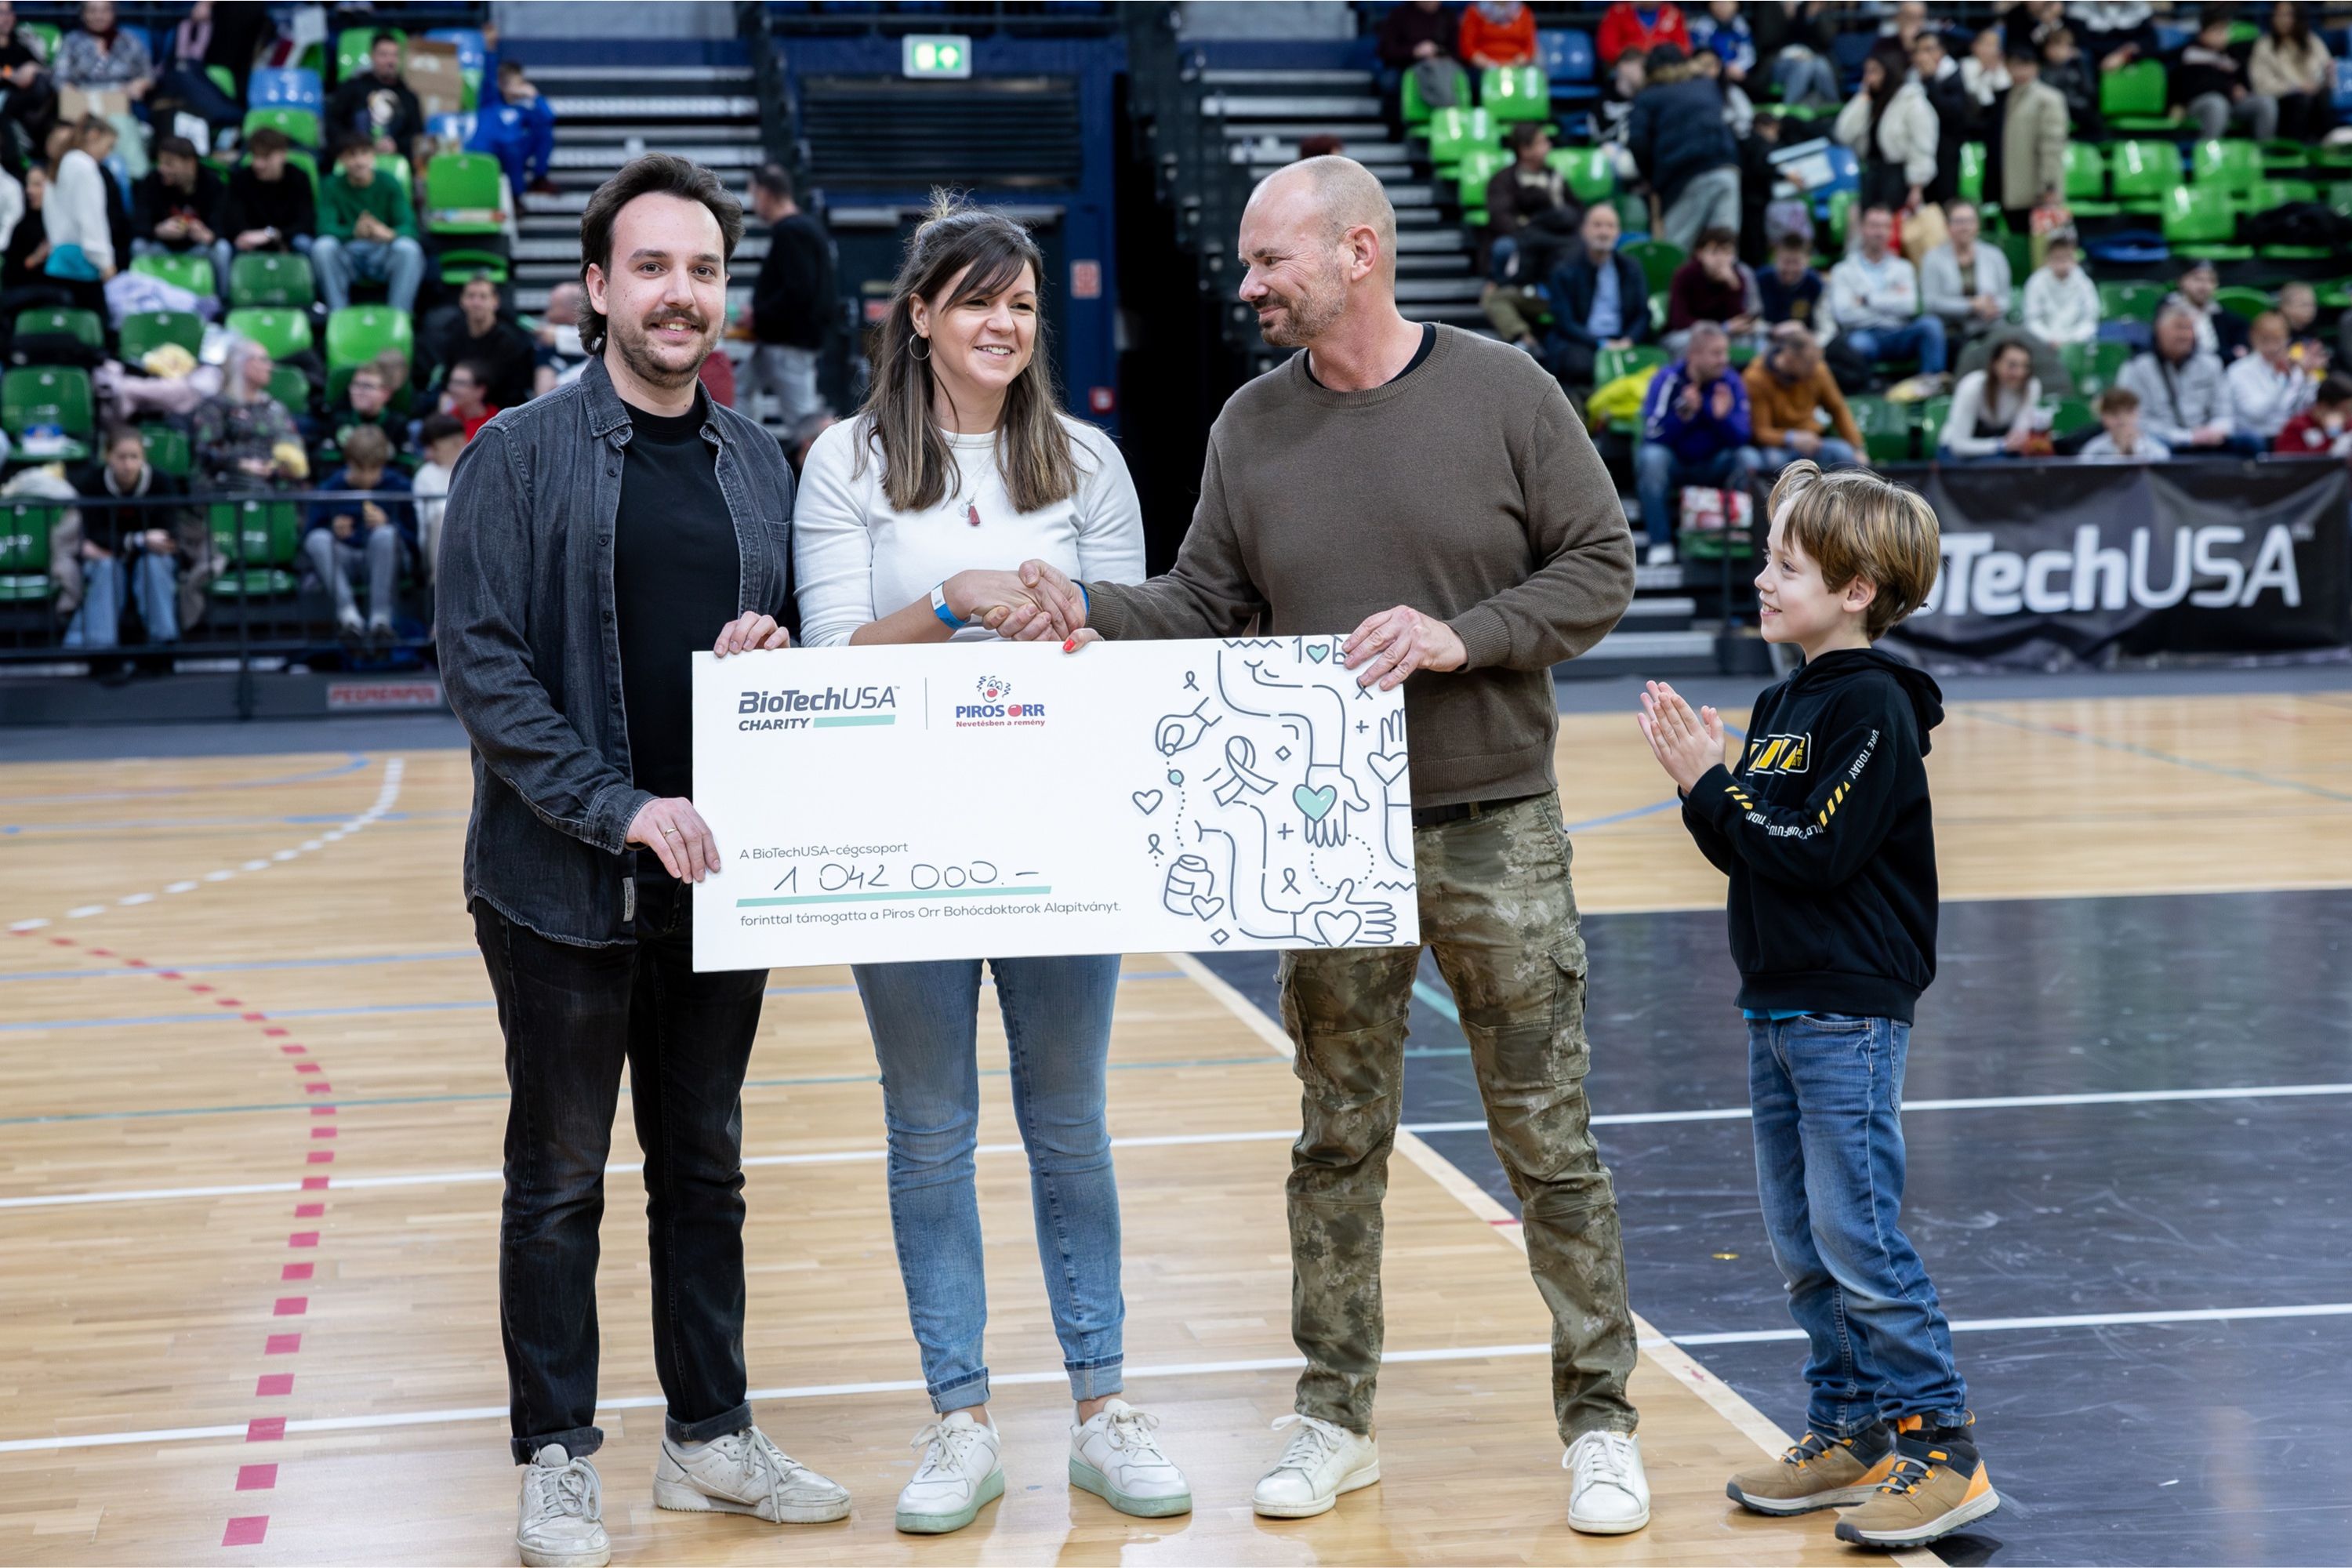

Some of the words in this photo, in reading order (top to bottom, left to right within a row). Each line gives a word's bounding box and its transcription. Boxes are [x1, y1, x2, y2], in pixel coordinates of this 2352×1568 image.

[956, 704, 1005, 719] PIROS
[739, 717, 811, 731] CHARITY
[1848, 750, 1871, 779] TODAY
[739, 849, 750, 860] A
[753, 842, 909, 859] BioTechUSA-cégcsoport
[774, 866, 797, 894] 1
[819, 863, 890, 891] 042
[740, 913, 793, 927] forinttal
[796, 911, 867, 926] támogatta
[869, 912, 879, 920] a
[882, 908, 916, 920] Piros
[917, 906, 941, 918] Orr
[943, 902, 1041, 917] Bohócdoktorok
[1044, 901, 1122, 915] Alapítványt.
